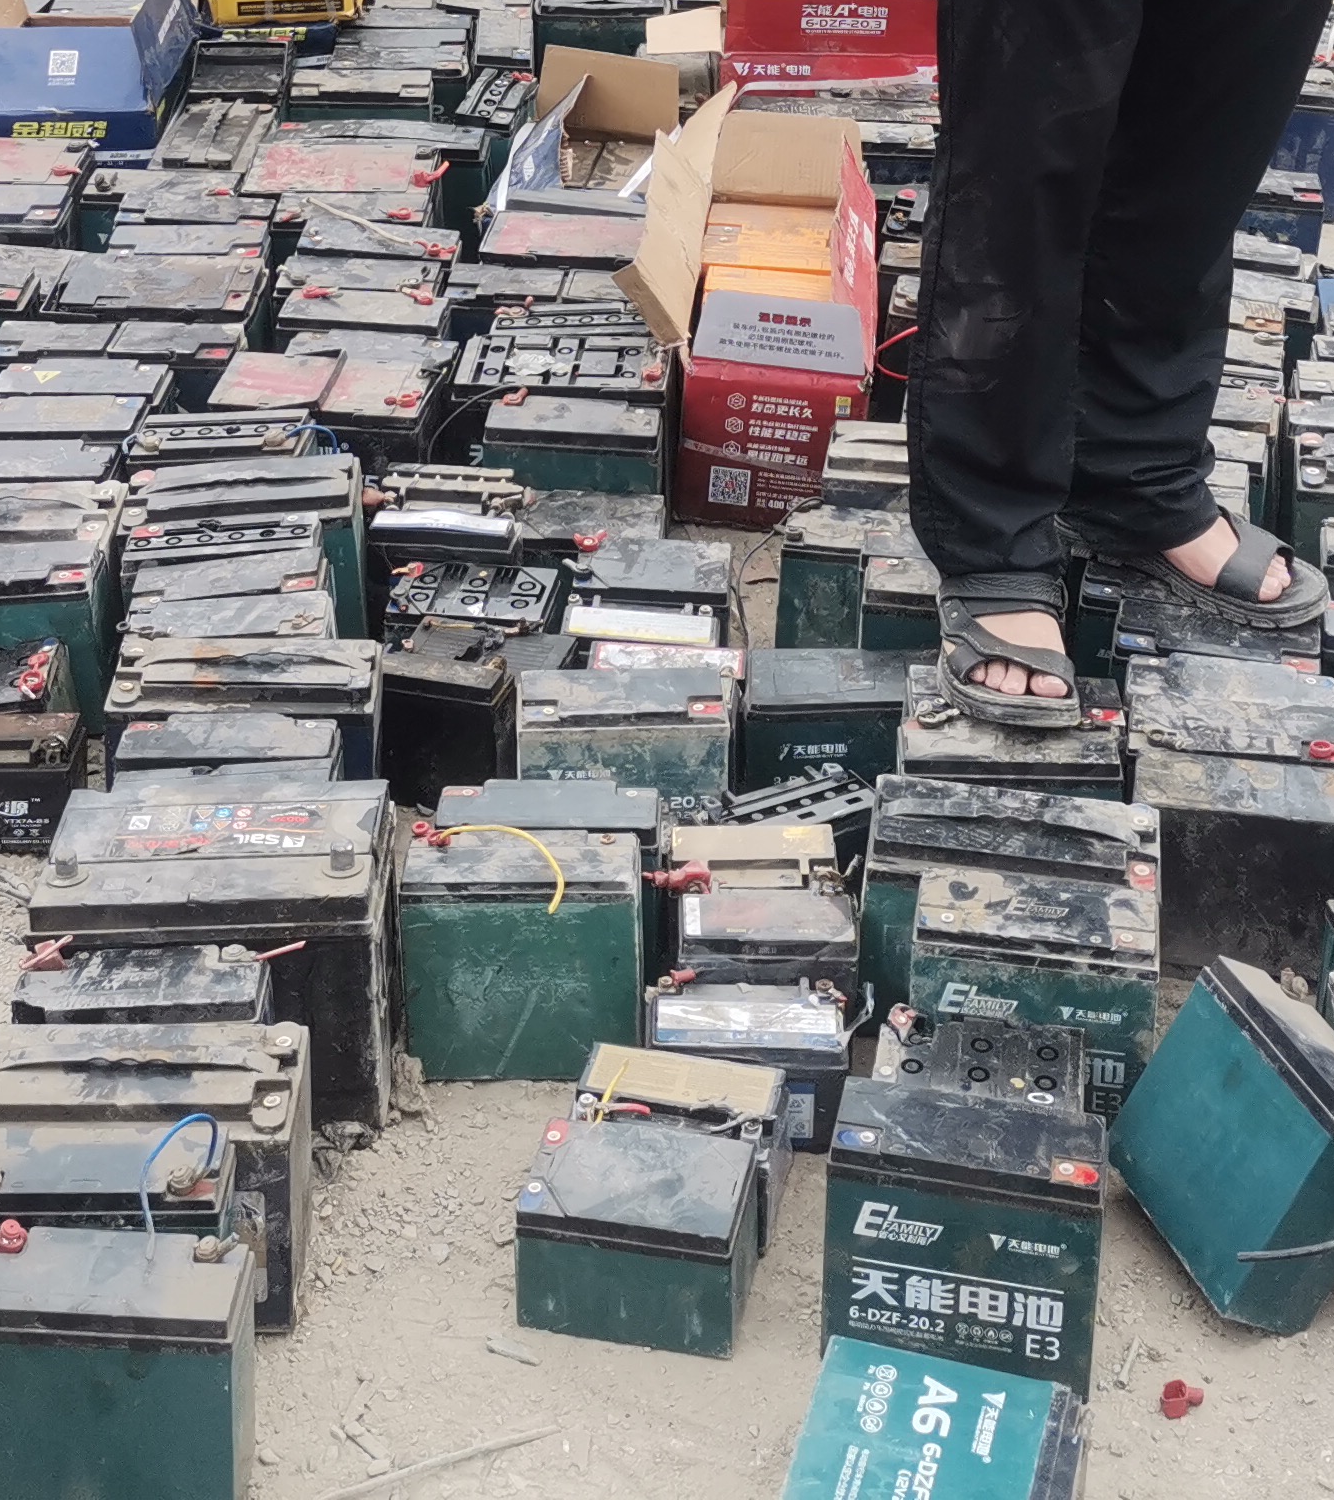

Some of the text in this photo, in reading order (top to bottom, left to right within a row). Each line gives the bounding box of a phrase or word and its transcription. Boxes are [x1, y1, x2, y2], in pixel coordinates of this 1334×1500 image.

[751, 402, 813, 419] 寿命更长久
[793, 744, 848, 755] 天能电池
[965, 999, 1011, 1012] FAMILY
[882, 1220, 936, 1238] FAMILY
[1008, 1239, 1060, 1256] 天能电池
[851, 1266, 1064, 1333] 天能电池
[849, 1305, 945, 1333] 6-DZF-20.2
[1025, 1334, 1060, 1361] E3
[912, 1375, 958, 1437] A6
